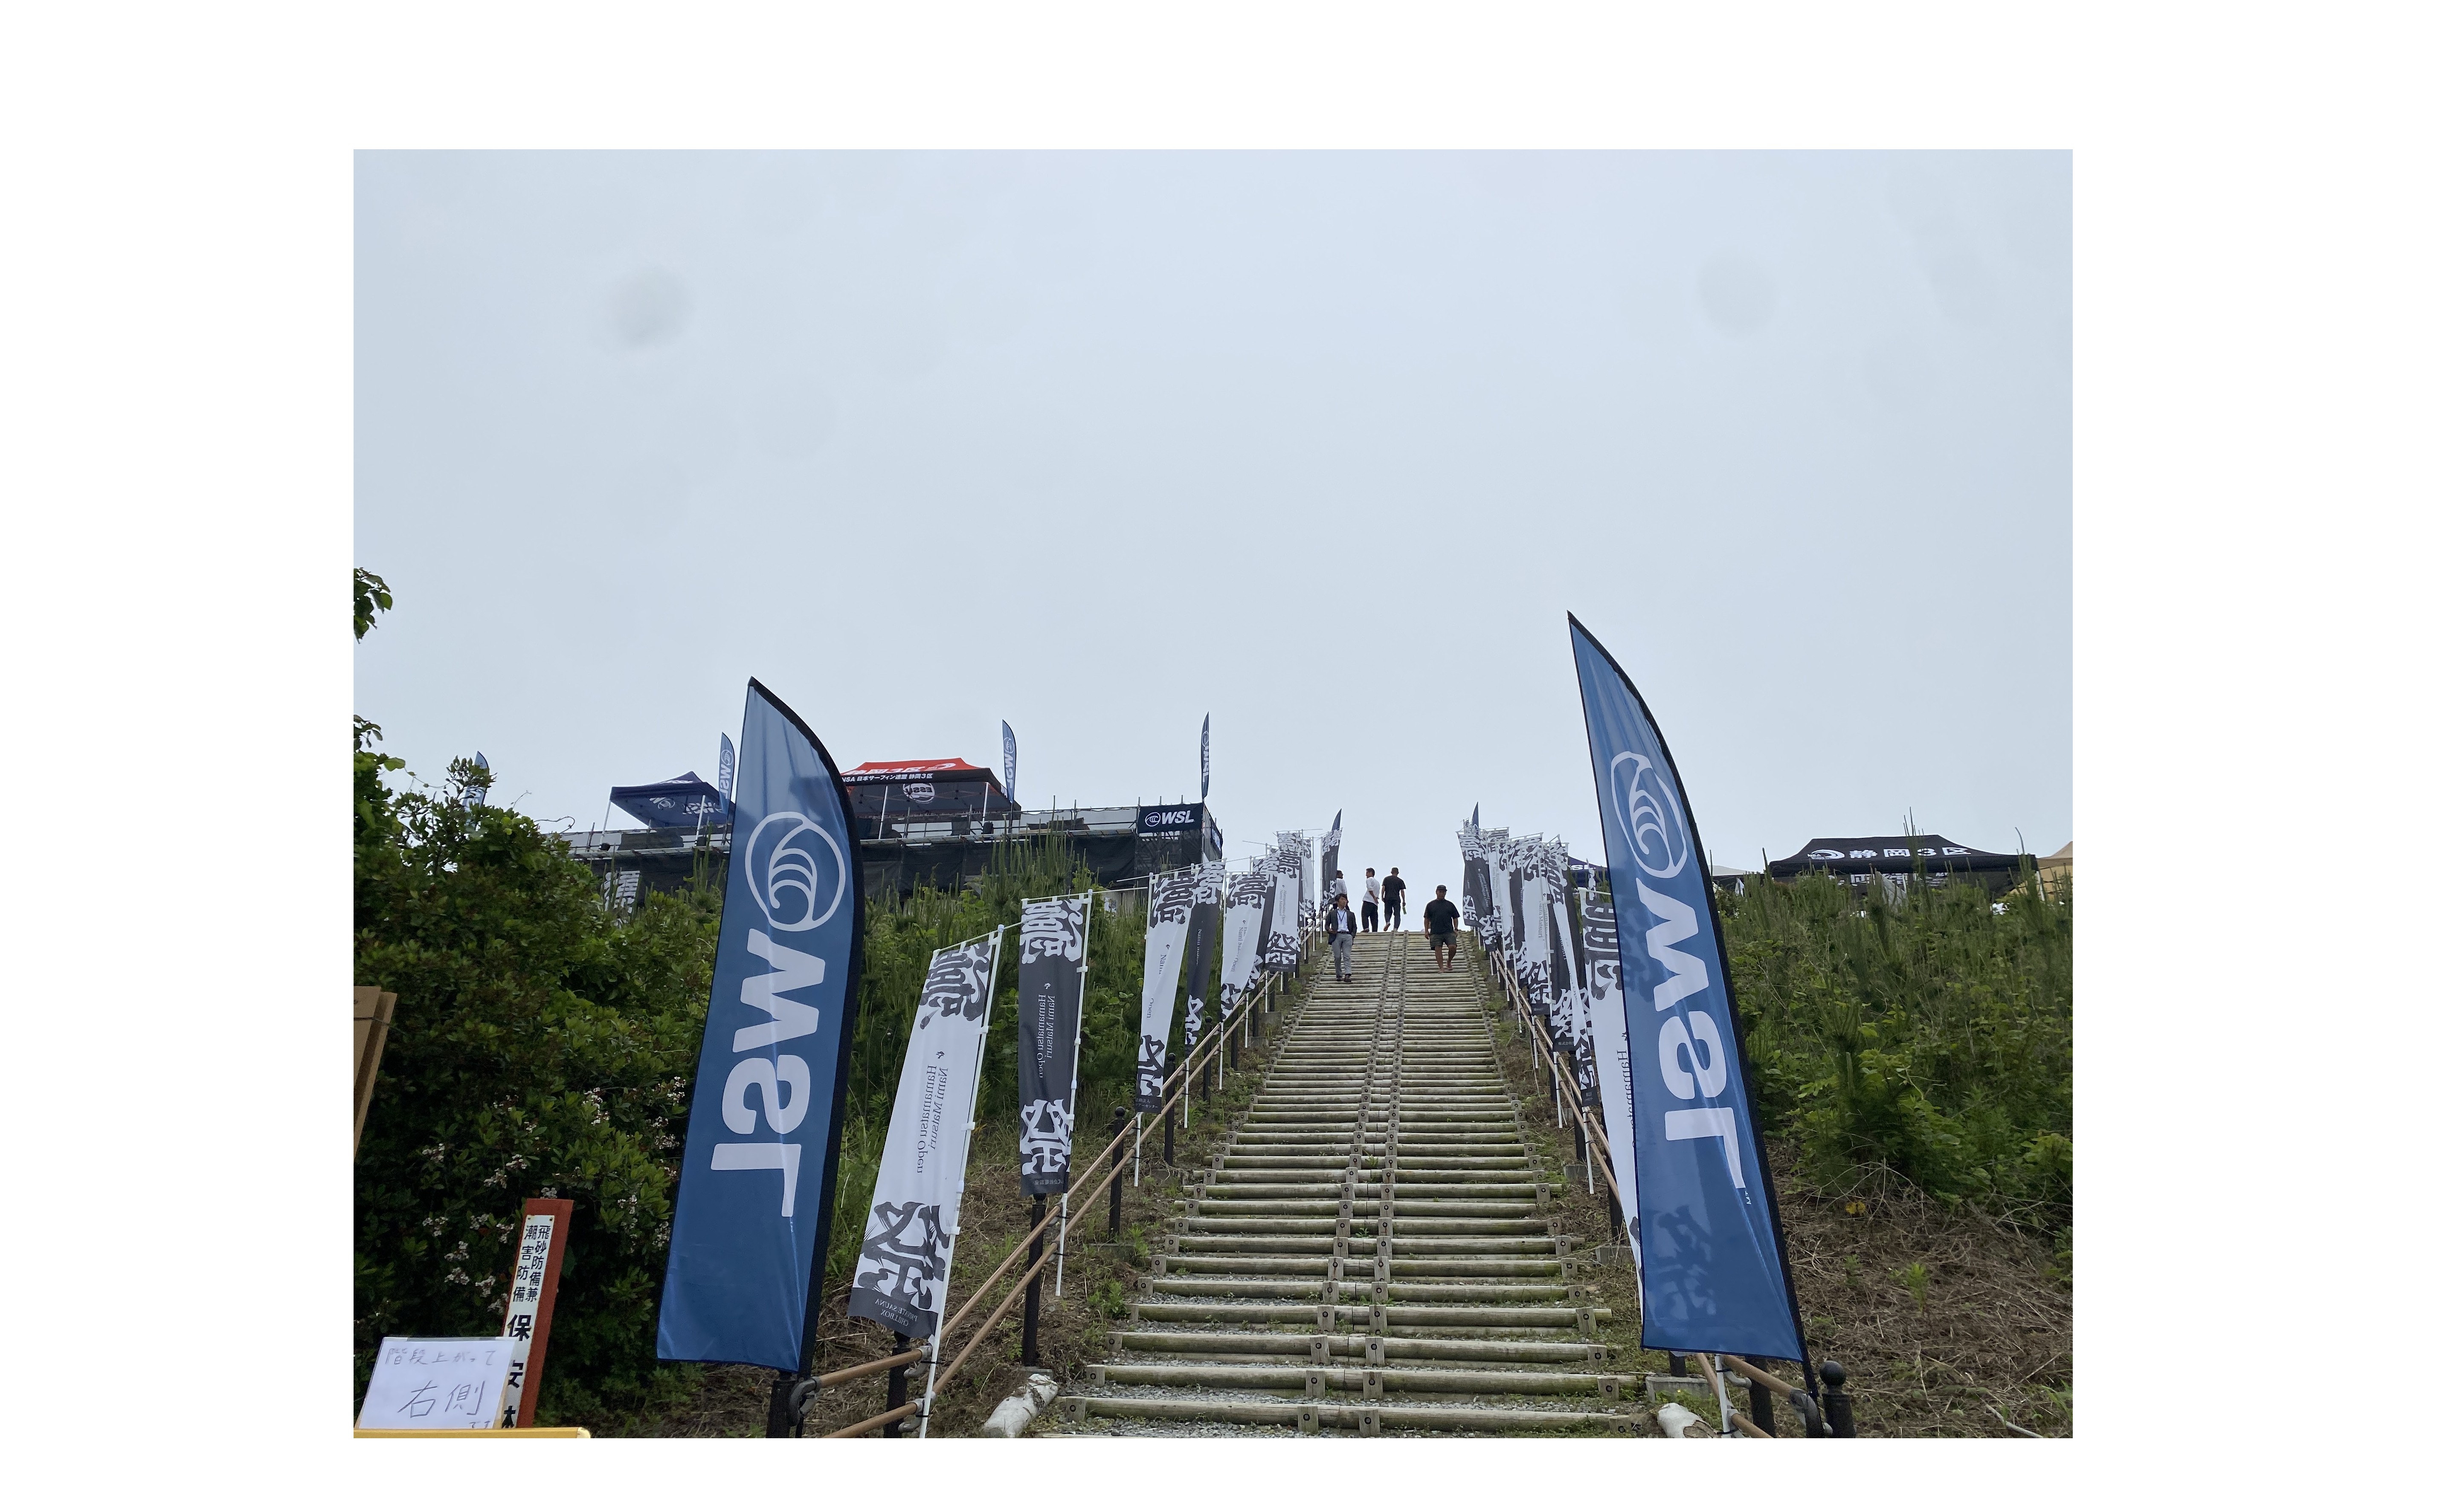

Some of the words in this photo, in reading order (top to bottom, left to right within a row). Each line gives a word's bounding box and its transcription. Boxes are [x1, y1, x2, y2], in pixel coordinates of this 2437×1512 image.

[1162, 810, 1194, 824] WSL
[1850, 847, 1971, 858] 静岡3区
[1267, 930, 1296, 964] 祭
[512, 1225, 539, 1303] 潮害防備
[525, 1225, 551, 1303] 飛砂防備兼
[385, 1348, 496, 1365] 階段上がって
[397, 1380, 485, 1418] 右側
